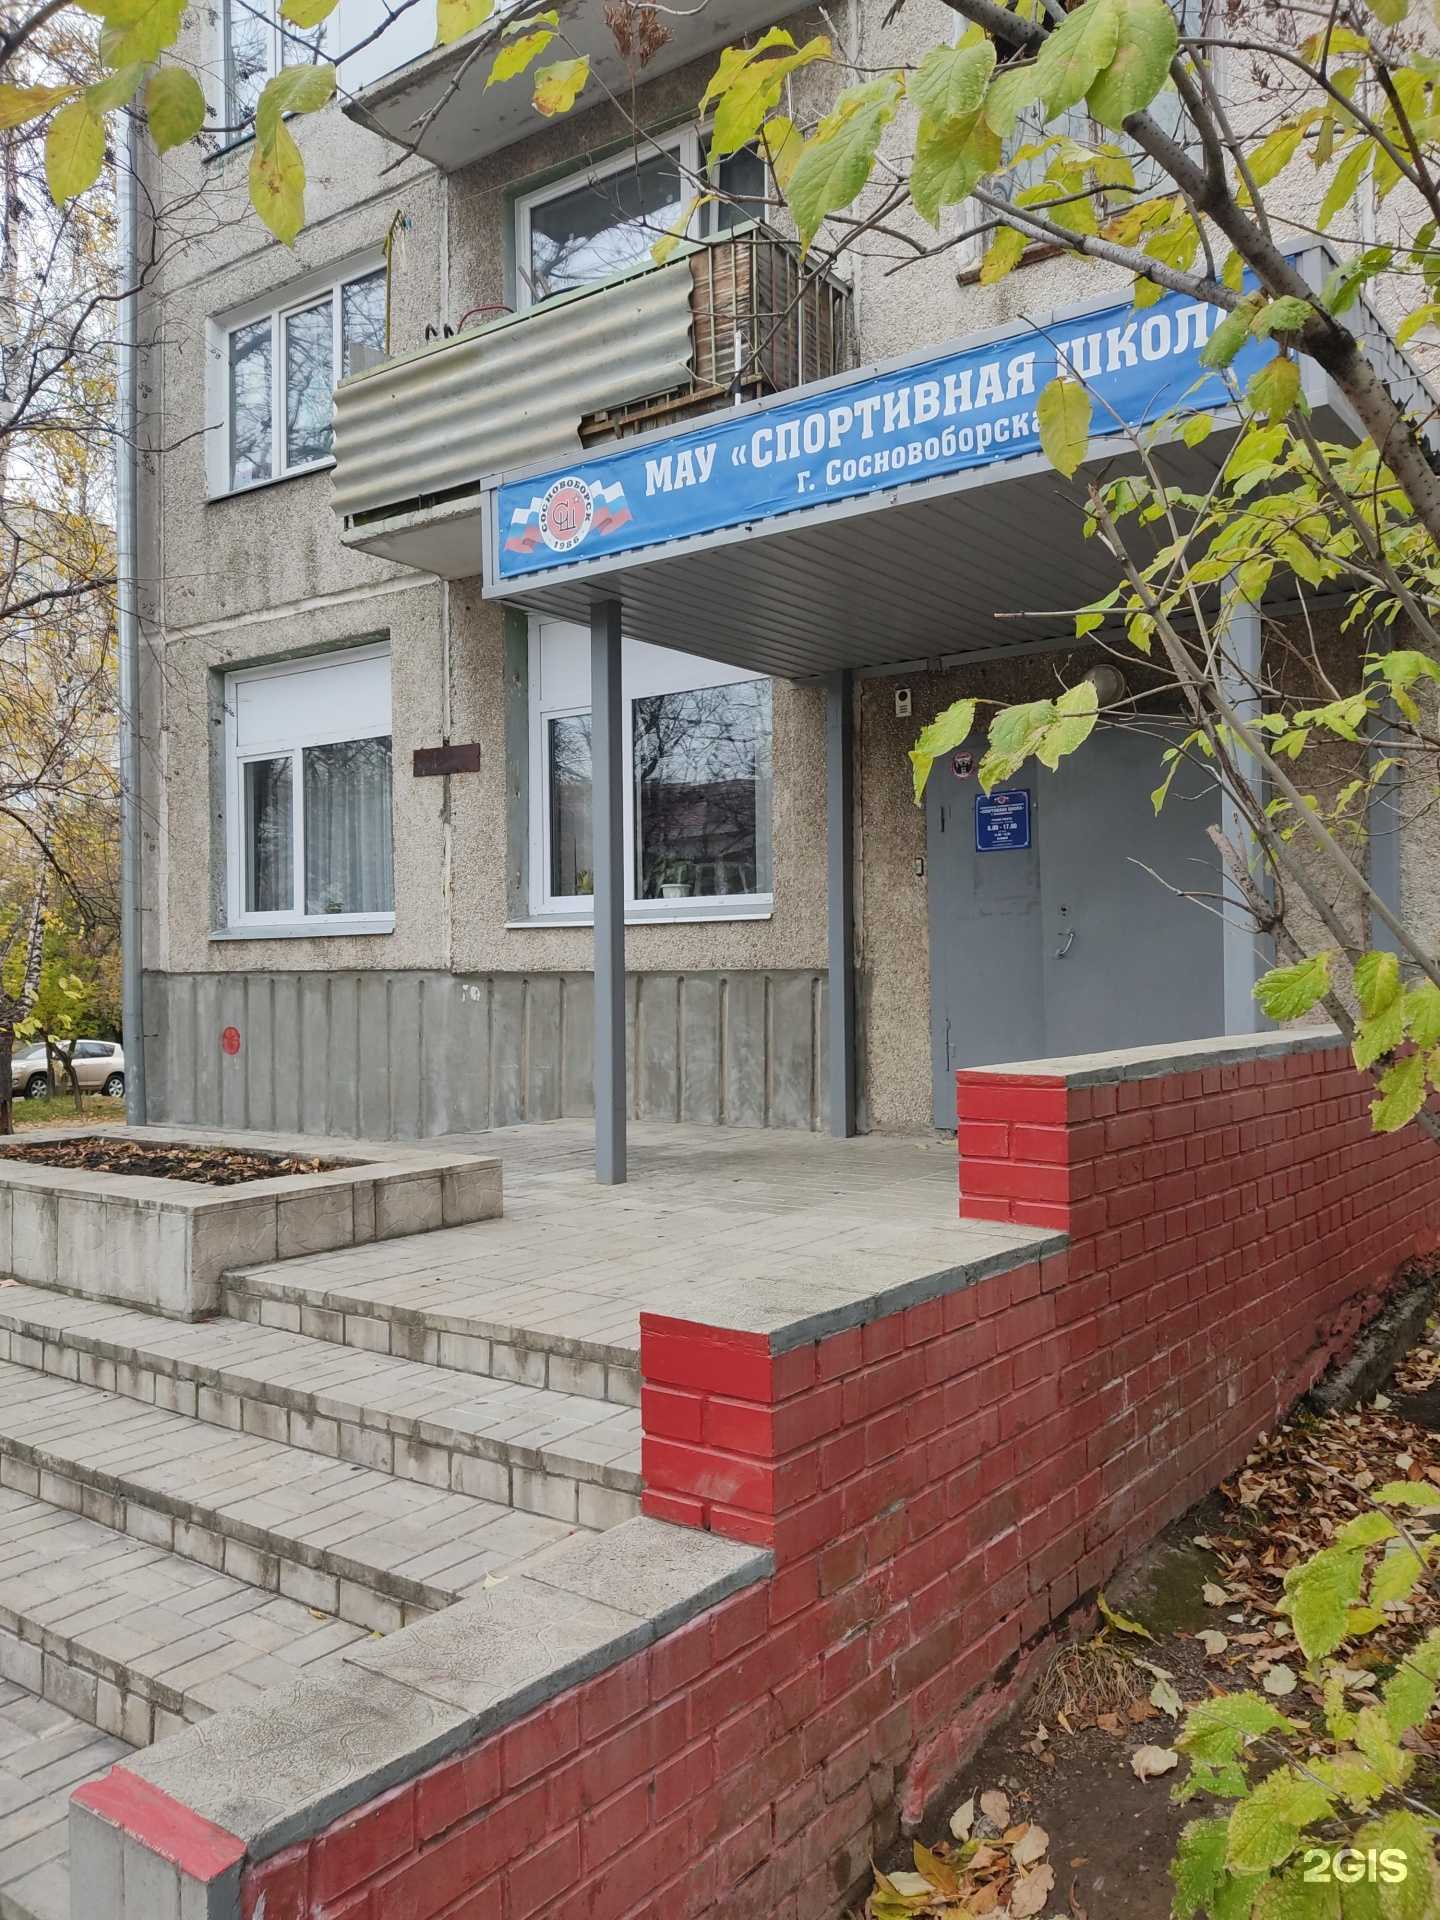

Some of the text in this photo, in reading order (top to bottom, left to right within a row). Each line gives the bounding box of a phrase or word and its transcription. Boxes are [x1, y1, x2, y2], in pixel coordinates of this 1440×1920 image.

[645, 443, 717, 497] МАУ
[731, 351, 1036, 468] «СПОРТИВНАЯ
[797, 470, 816, 493] г.
[540, 479, 592, 533] СОСНОВОБОРСК
[554, 535, 580, 550] 1986
